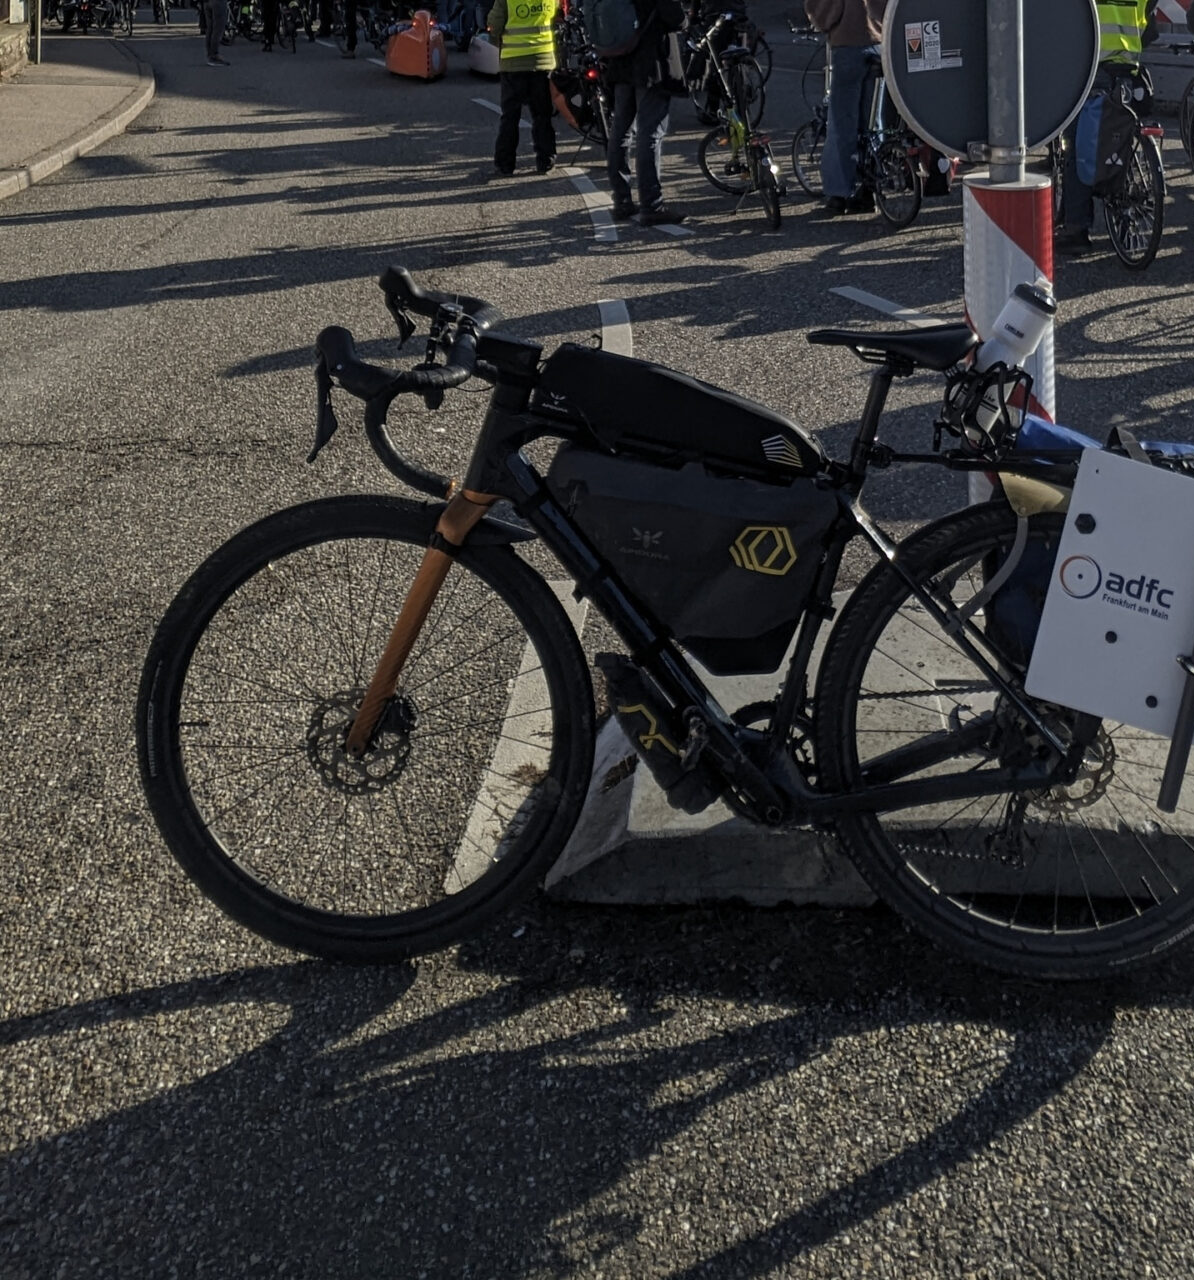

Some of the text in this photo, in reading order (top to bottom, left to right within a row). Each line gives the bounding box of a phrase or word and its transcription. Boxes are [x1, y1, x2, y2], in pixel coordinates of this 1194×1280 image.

[530, 1, 552, 13] adfc
[923, 22, 939, 35] CE
[1105, 572, 1174, 609] adfc
[1102, 593, 1169, 621] Frankfurt am Main
